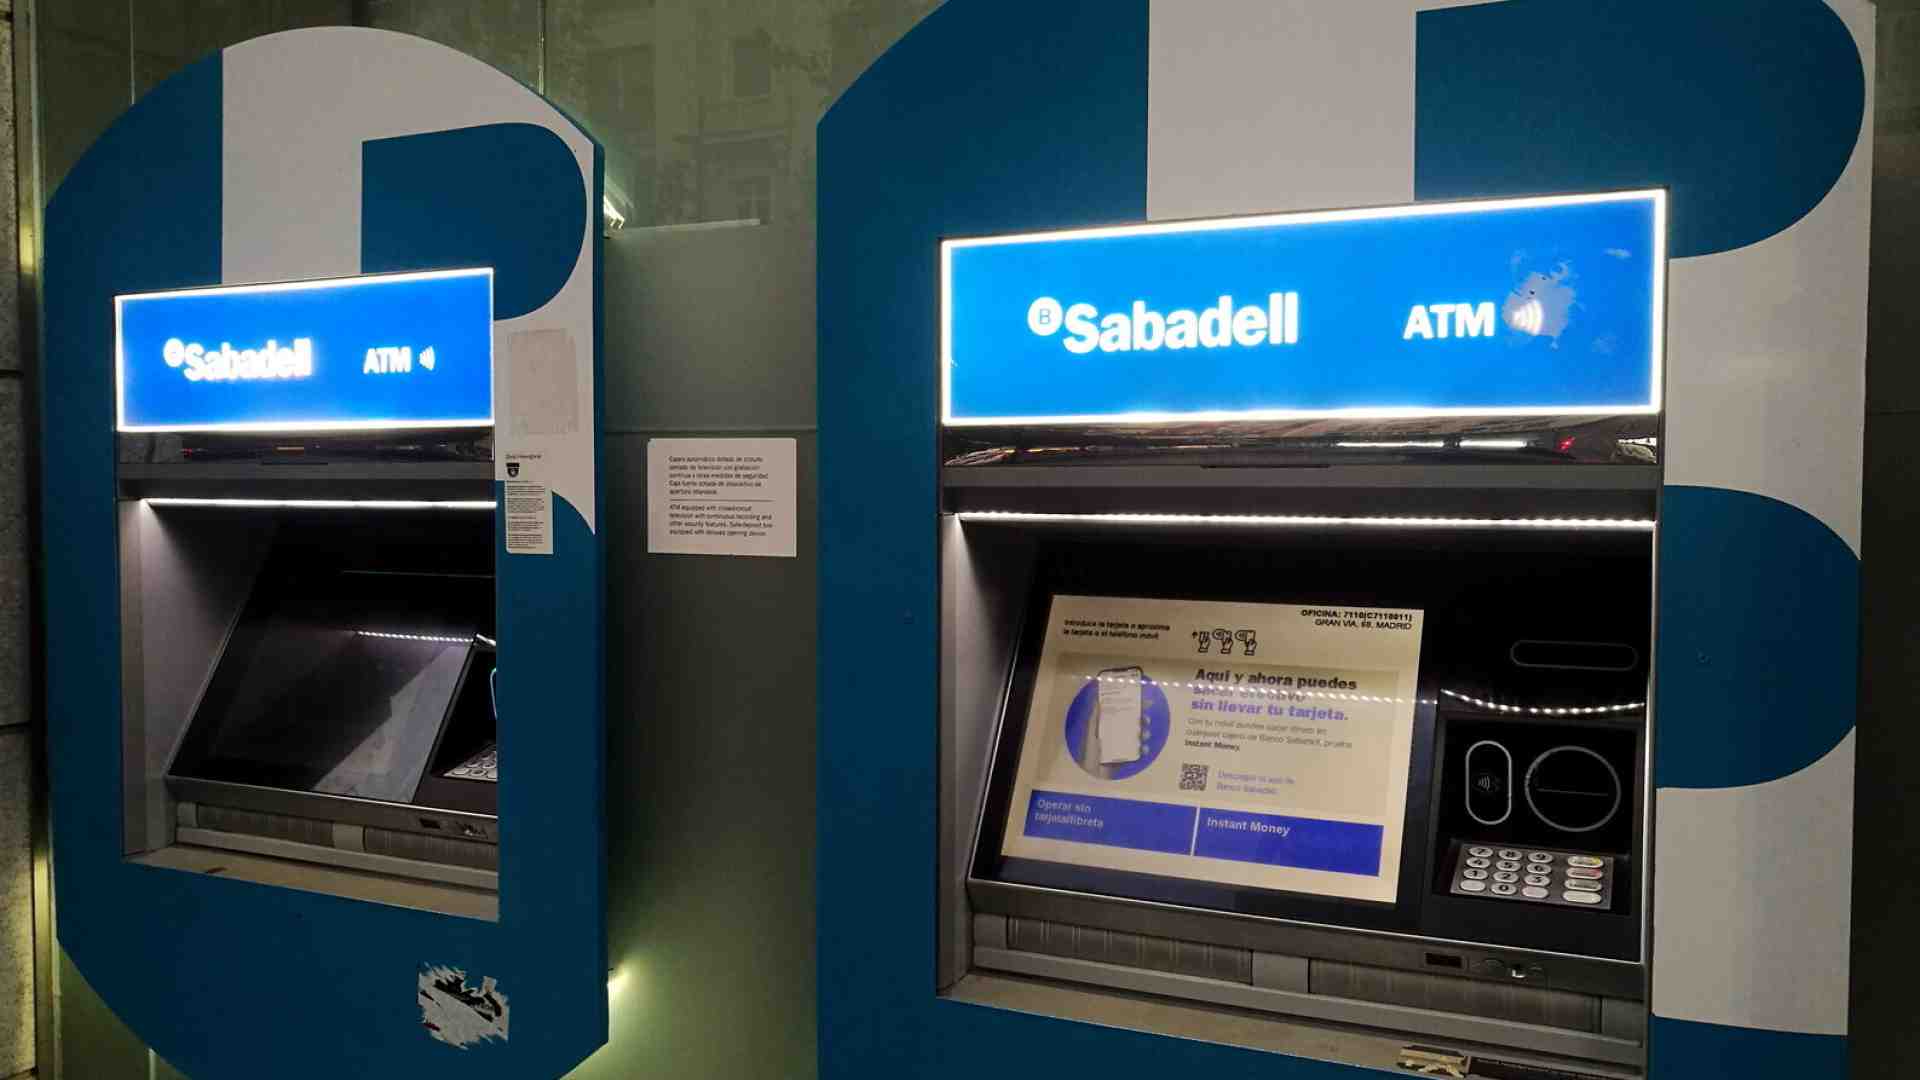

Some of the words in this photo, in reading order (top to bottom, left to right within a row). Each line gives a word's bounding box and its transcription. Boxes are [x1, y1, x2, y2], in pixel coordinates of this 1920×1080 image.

[1063, 292, 1298, 353] Sabadell
[1403, 302, 1495, 340] ATM
[184, 338, 312, 381] Sabadell
[363, 346, 412, 374] ATM
[1301, 609, 1340, 618] OFICINA:
[1376, 622, 1412, 630] MADRID
[1248, 672, 1293, 687] ahora
[1296, 677, 1358, 691] puedes
[1191, 699, 1214, 711] sin
[1218, 701, 1262, 715] llevar
[1267, 703, 1282, 716] tu
[1185, 739, 1212, 748] Instant
[1037, 799, 1072, 813] Operar
[1075, 803, 1092, 814] sin
[1207, 816, 1247, 831] Instant
[1249, 821, 1291, 837] Money
